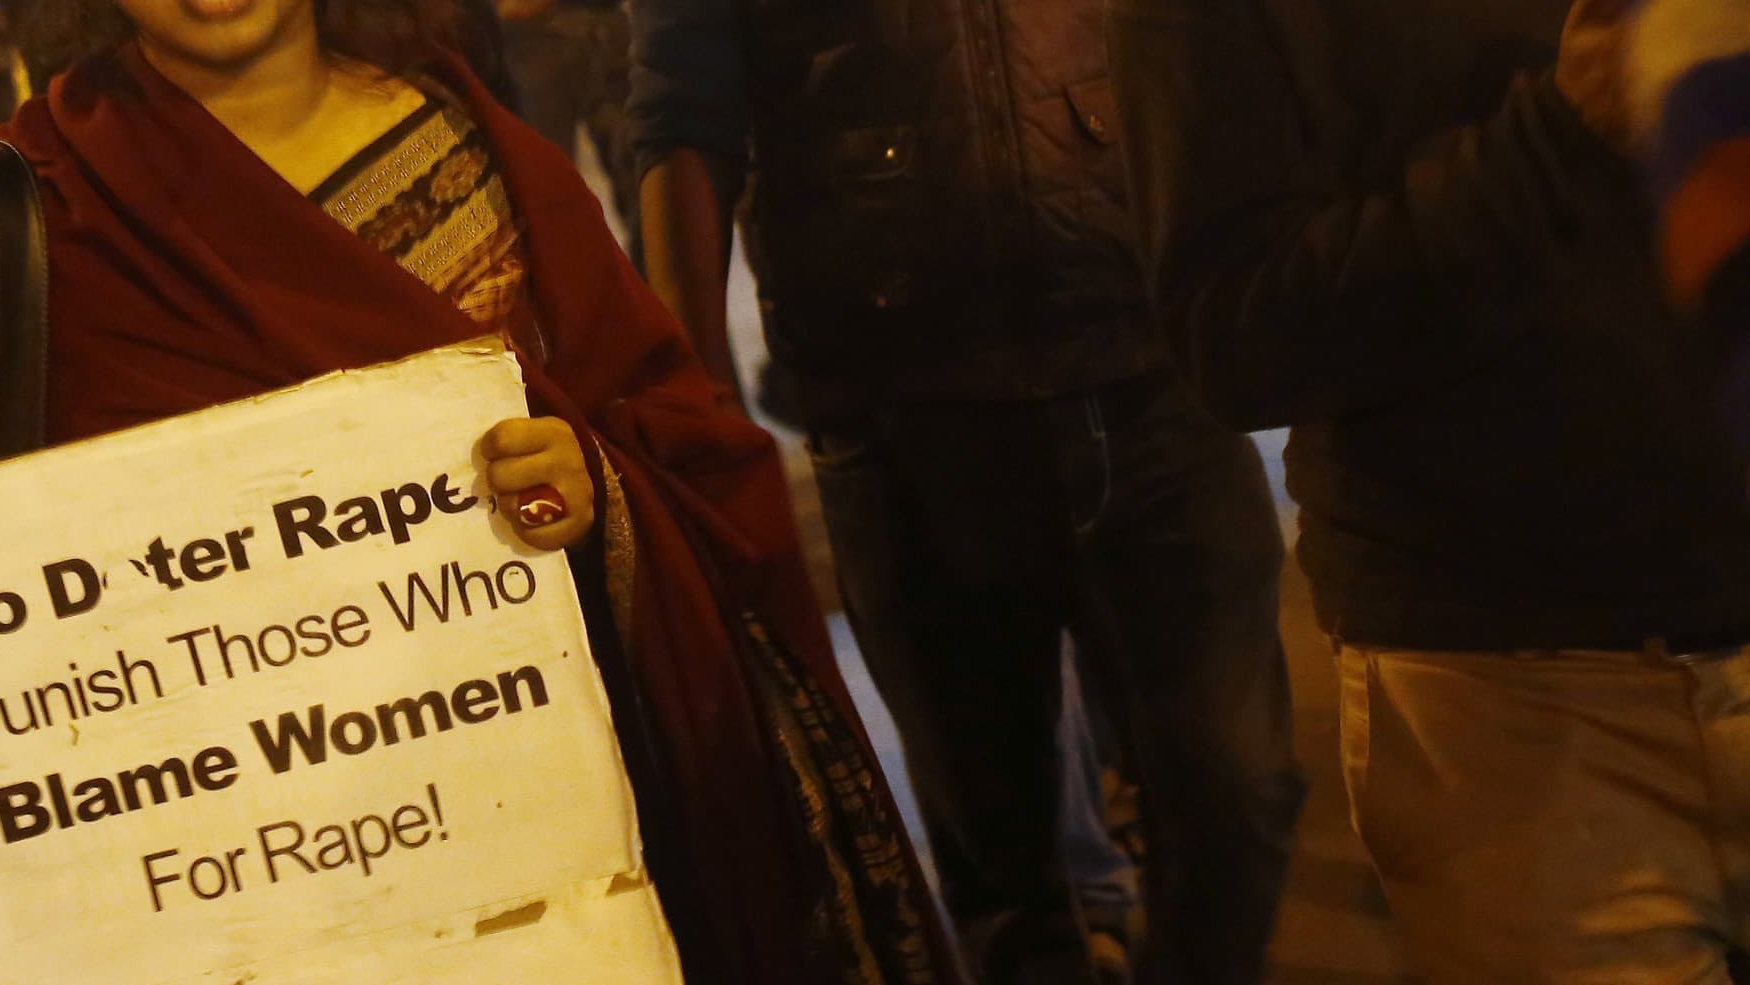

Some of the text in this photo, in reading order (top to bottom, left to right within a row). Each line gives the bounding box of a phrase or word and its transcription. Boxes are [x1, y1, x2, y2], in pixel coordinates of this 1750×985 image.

[41, 524, 256, 620] Dter
[165, 604, 372, 688] Those
[377, 559, 537, 633] Who
[249, 664, 550, 776] Women
[141, 782, 448, 914] For Rape!
